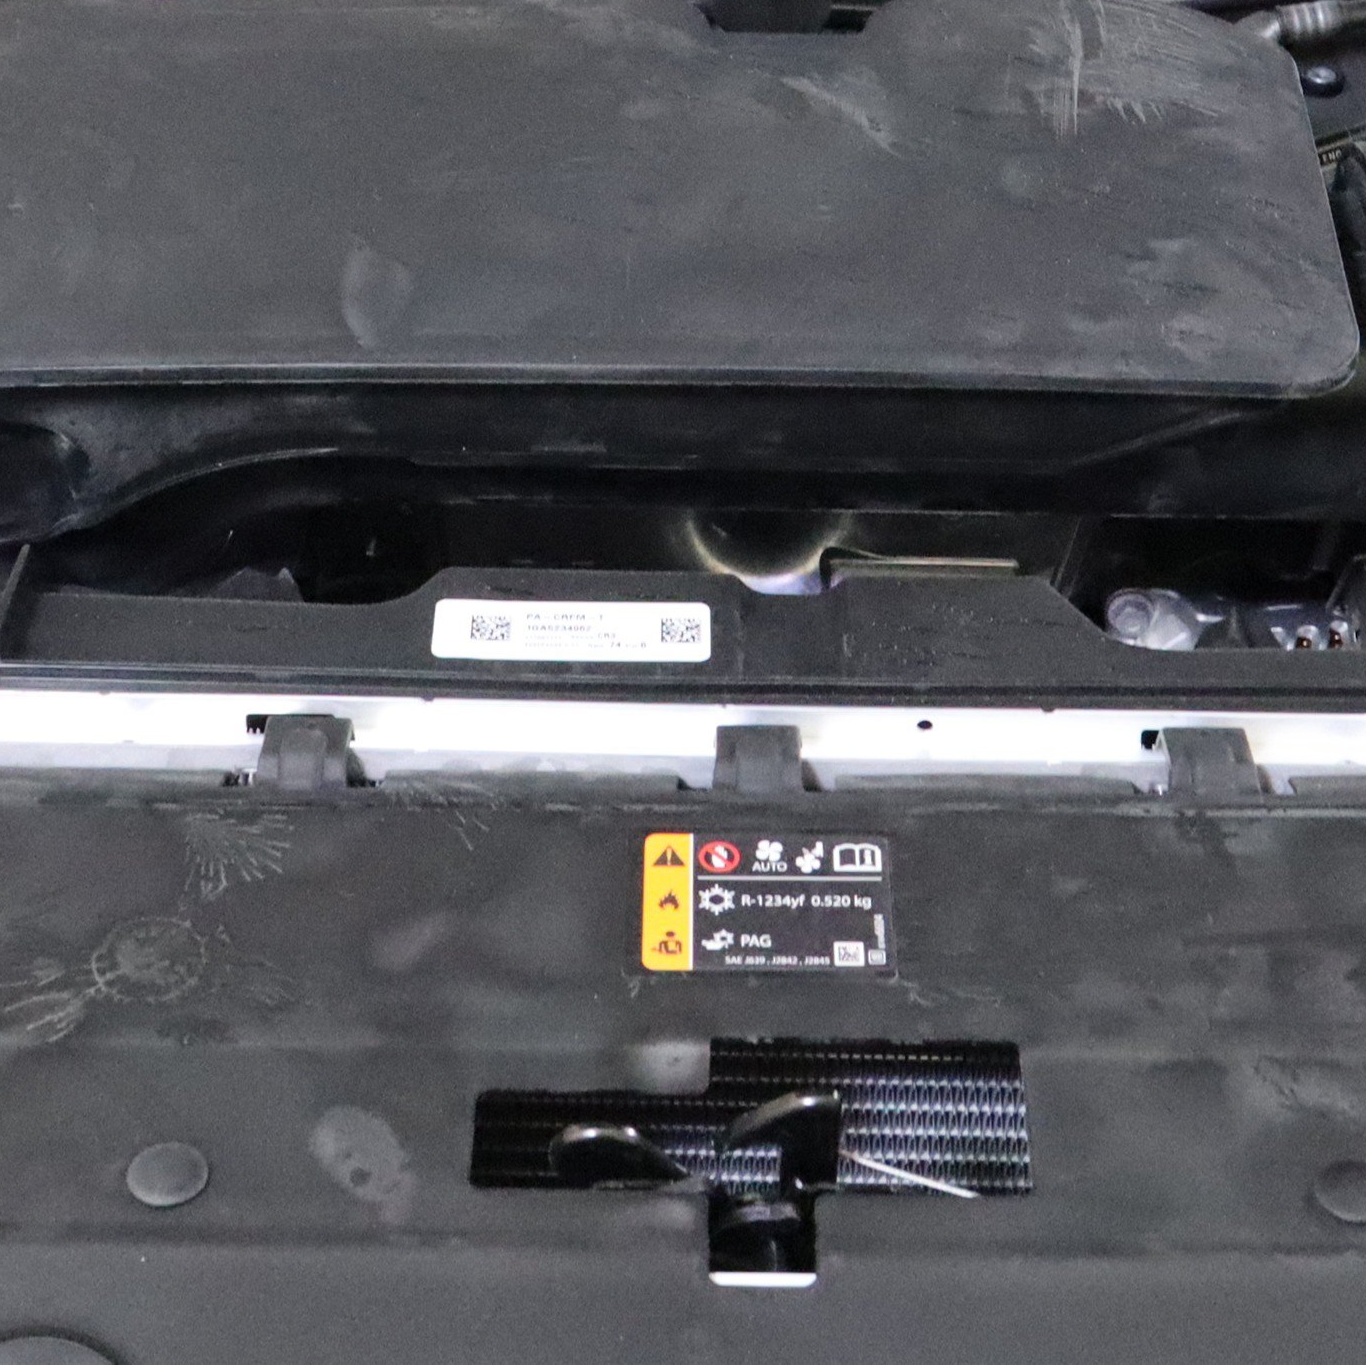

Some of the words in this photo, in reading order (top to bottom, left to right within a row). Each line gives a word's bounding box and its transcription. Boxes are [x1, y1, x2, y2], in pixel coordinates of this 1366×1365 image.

[752, 862, 787, 873] AUTO
[741, 895, 804, 909] R-1234yf
[811, 895, 851, 907] 0.520
[853, 895, 872, 910] kg
[741, 934, 772, 948] PAG
